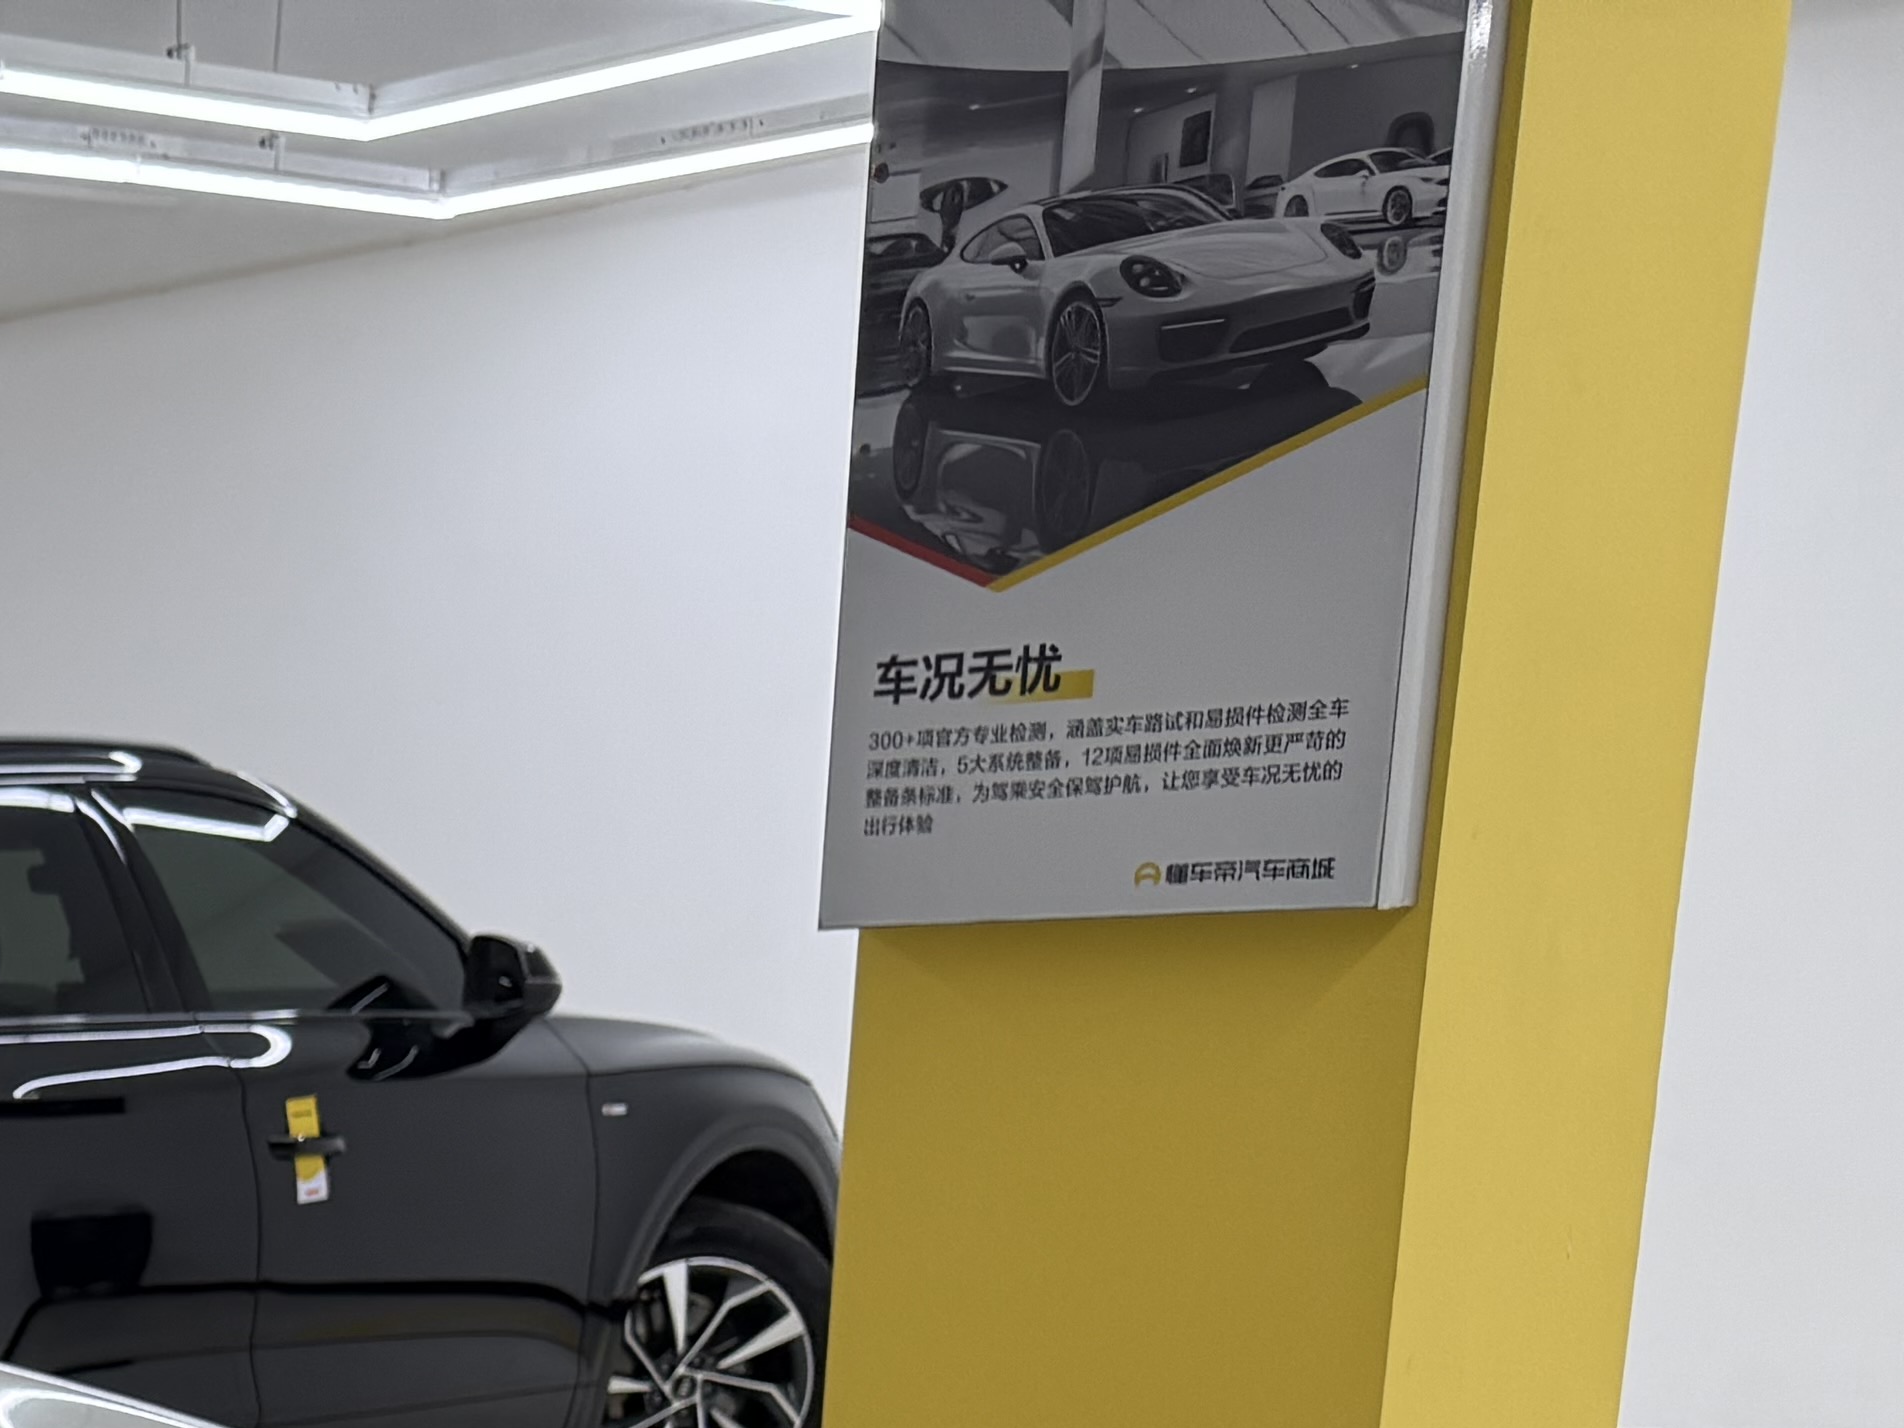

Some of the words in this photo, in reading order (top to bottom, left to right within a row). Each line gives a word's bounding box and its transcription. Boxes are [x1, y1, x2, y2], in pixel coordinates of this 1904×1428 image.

[873, 644, 1064, 705] 车况无忧
[863, 813, 934, 836] 出行体验
[1165, 857, 1336, 885] 懂车帝汽车商城
